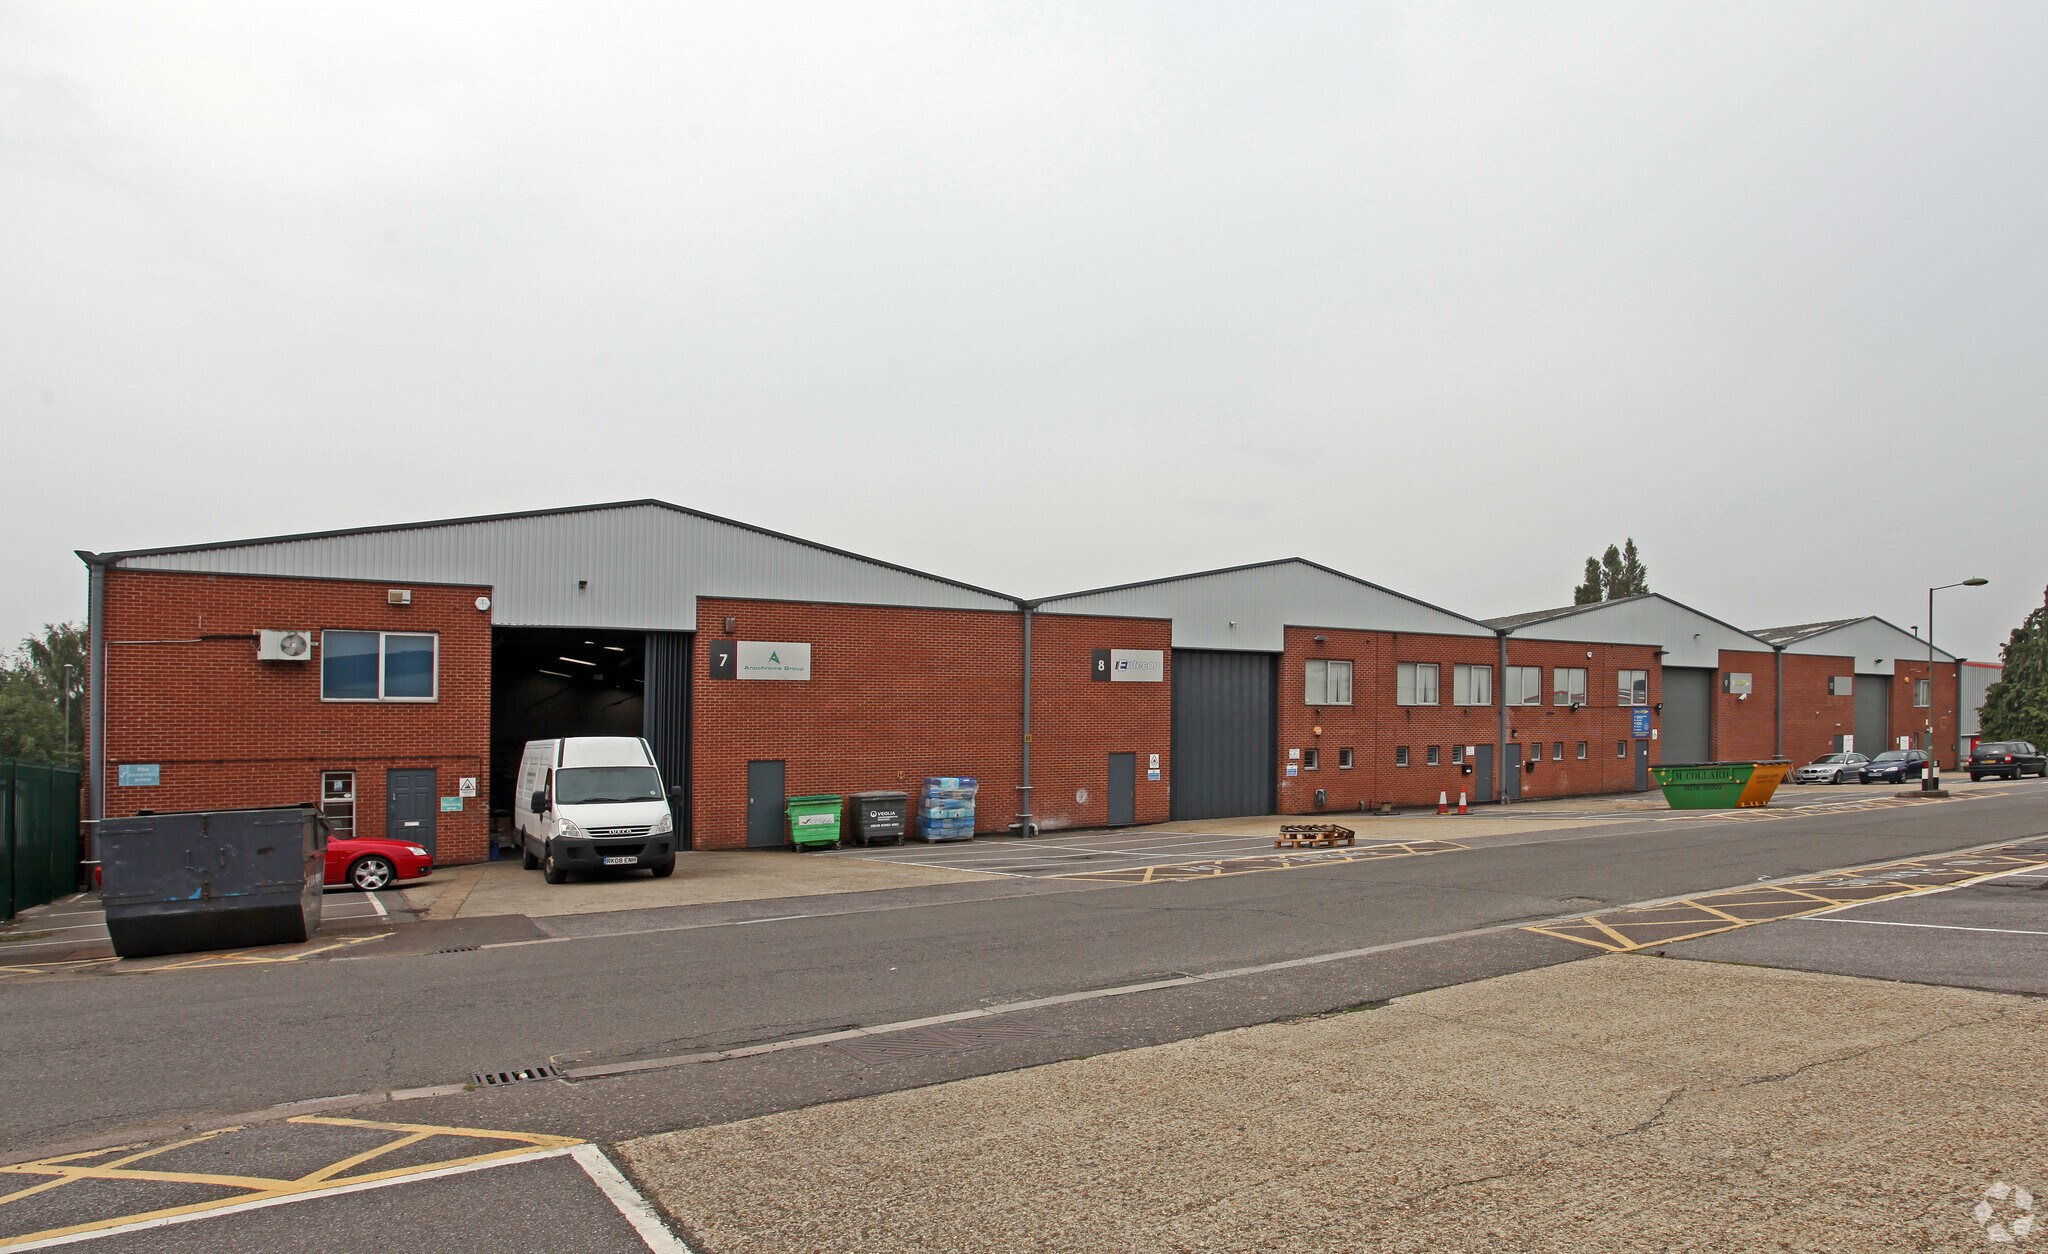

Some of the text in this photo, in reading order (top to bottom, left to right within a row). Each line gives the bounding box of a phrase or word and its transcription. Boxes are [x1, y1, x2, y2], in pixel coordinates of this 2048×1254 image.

[719, 653, 728, 667] 7
[1098, 659, 1105, 671] 8
[1676, 770, 1729, 780] M COLLARD
